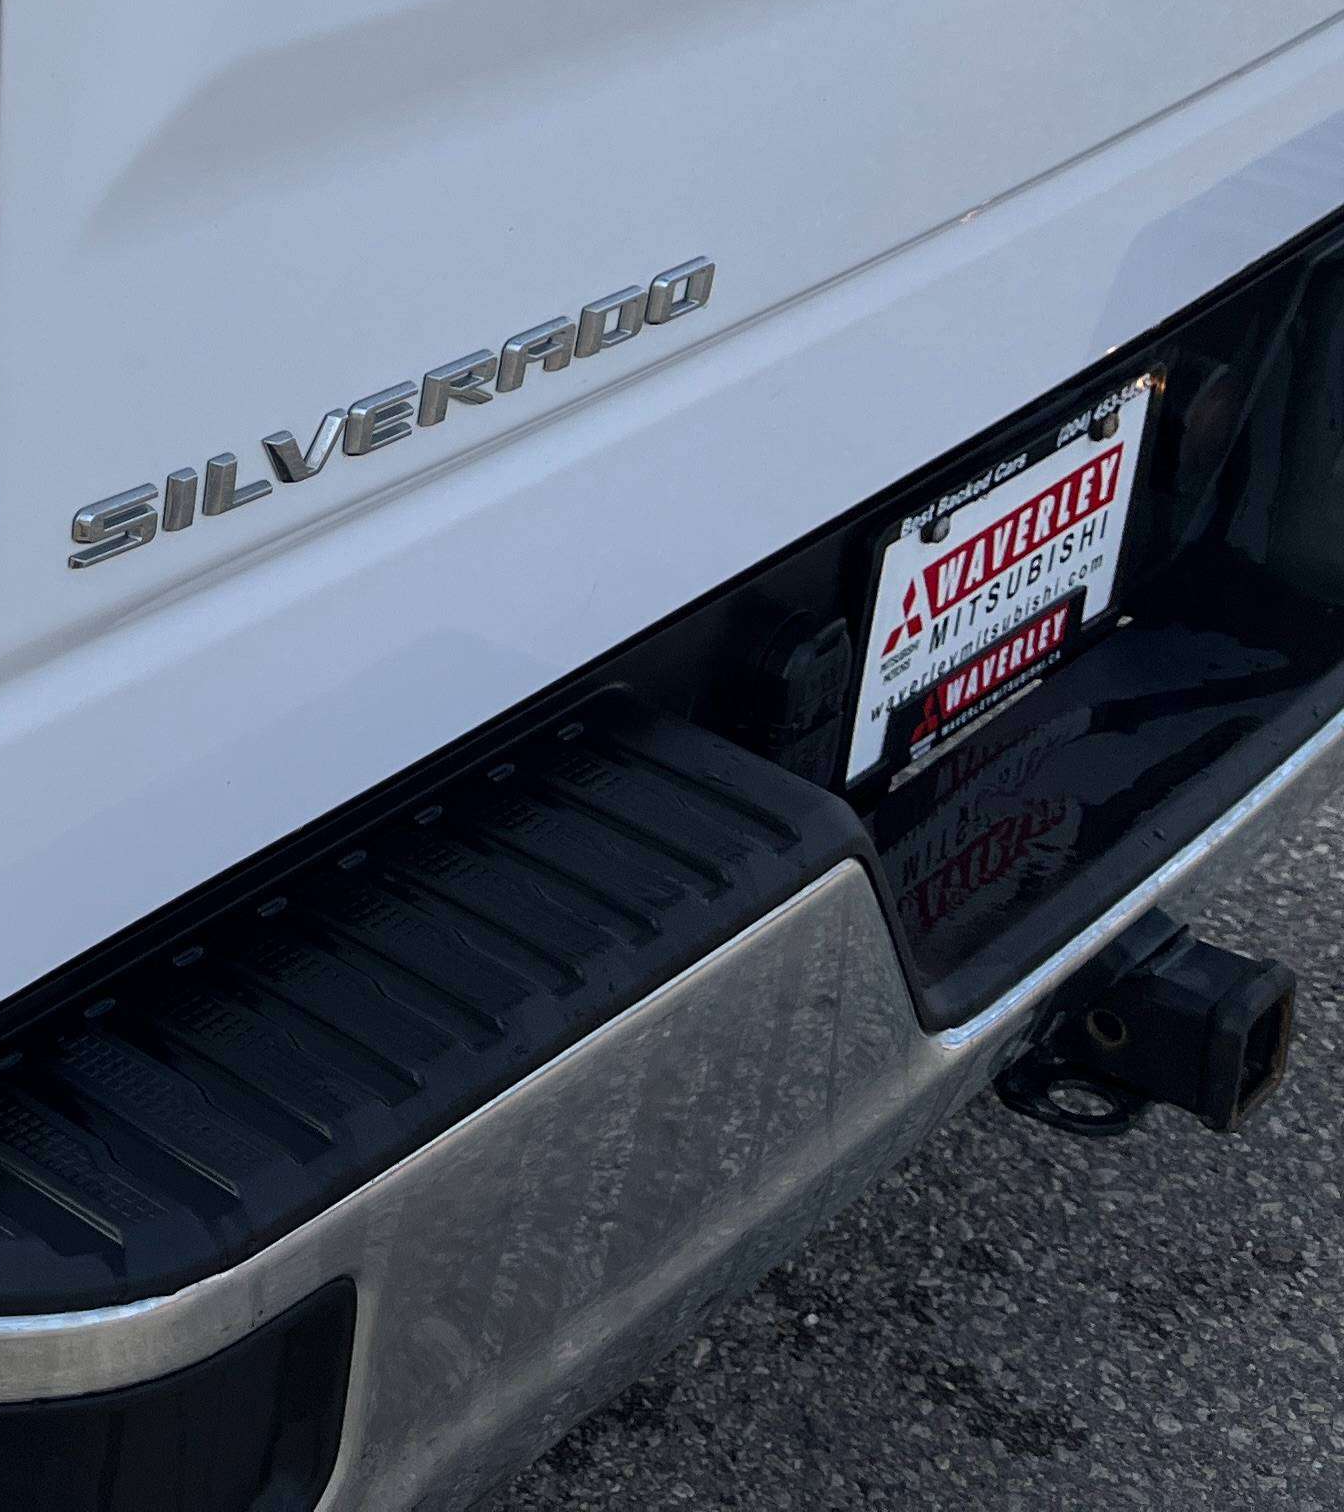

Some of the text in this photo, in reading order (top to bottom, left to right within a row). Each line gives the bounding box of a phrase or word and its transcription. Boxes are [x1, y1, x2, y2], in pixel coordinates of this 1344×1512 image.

[67, 255, 716, 569] SILVERADO
[994, 453, 1028, 483] Cars
[929, 509, 1109, 655] MITSUBISHI
[936, 450, 1120, 609] WAVERLEY
[871, 554, 1103, 722] waverleymitsubishi.com
[946, 606, 1067, 713] WAVERLEY
